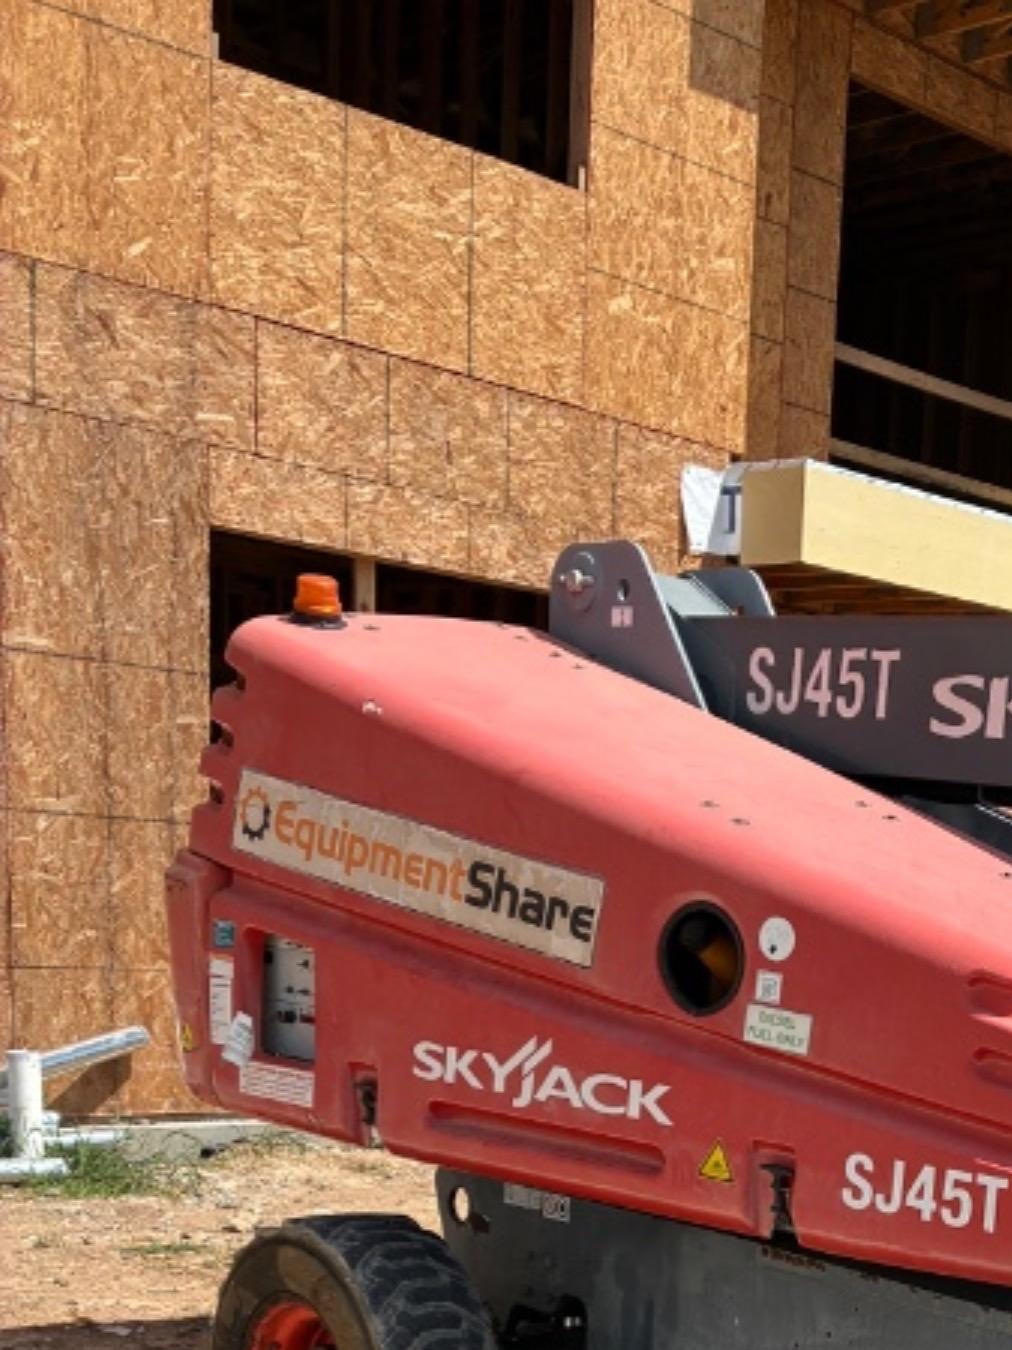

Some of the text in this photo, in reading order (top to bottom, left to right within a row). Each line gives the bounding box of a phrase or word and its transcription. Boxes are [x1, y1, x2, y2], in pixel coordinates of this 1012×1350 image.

[745, 646, 901, 720] SJ45T
[274, 800, 595, 943] EquipmentShare
[412, 1034, 674, 1127] SKYJACK
[842, 1151, 1009, 1235] SJ45T
